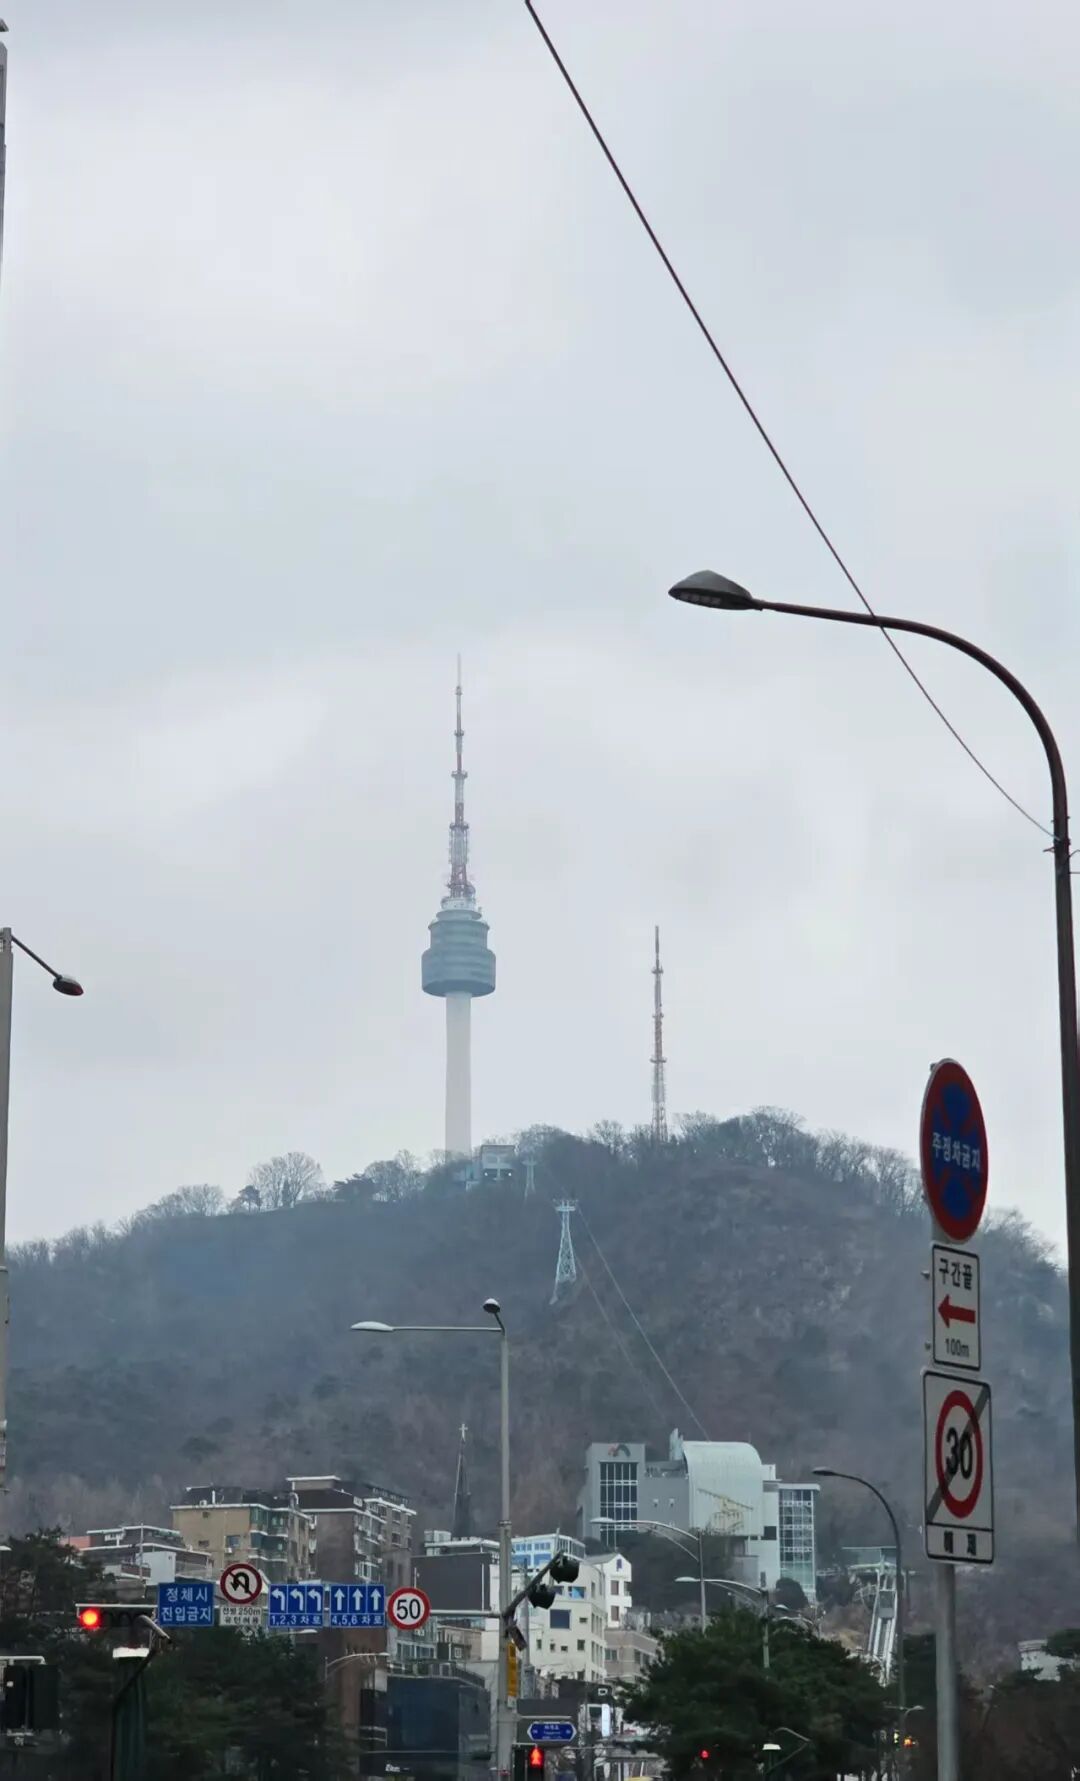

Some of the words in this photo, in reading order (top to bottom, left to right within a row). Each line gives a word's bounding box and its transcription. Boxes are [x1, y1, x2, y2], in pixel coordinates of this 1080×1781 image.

[932, 1132, 981, 1173] 주정차금지
[938, 1257, 973, 1291] 구간끝
[945, 1337, 970, 1358] 100m
[945, 1426, 973, 1480] 30
[166, 1586, 208, 1603] 정체시
[161, 1606, 212, 1622] 진입금지
[238, 1607, 261, 1616] 250m
[396, 1598, 421, 1620] 50
[271, 1615, 297, 1626] 1,2,3
[331, 1615, 358, 1626] 4,5,6
